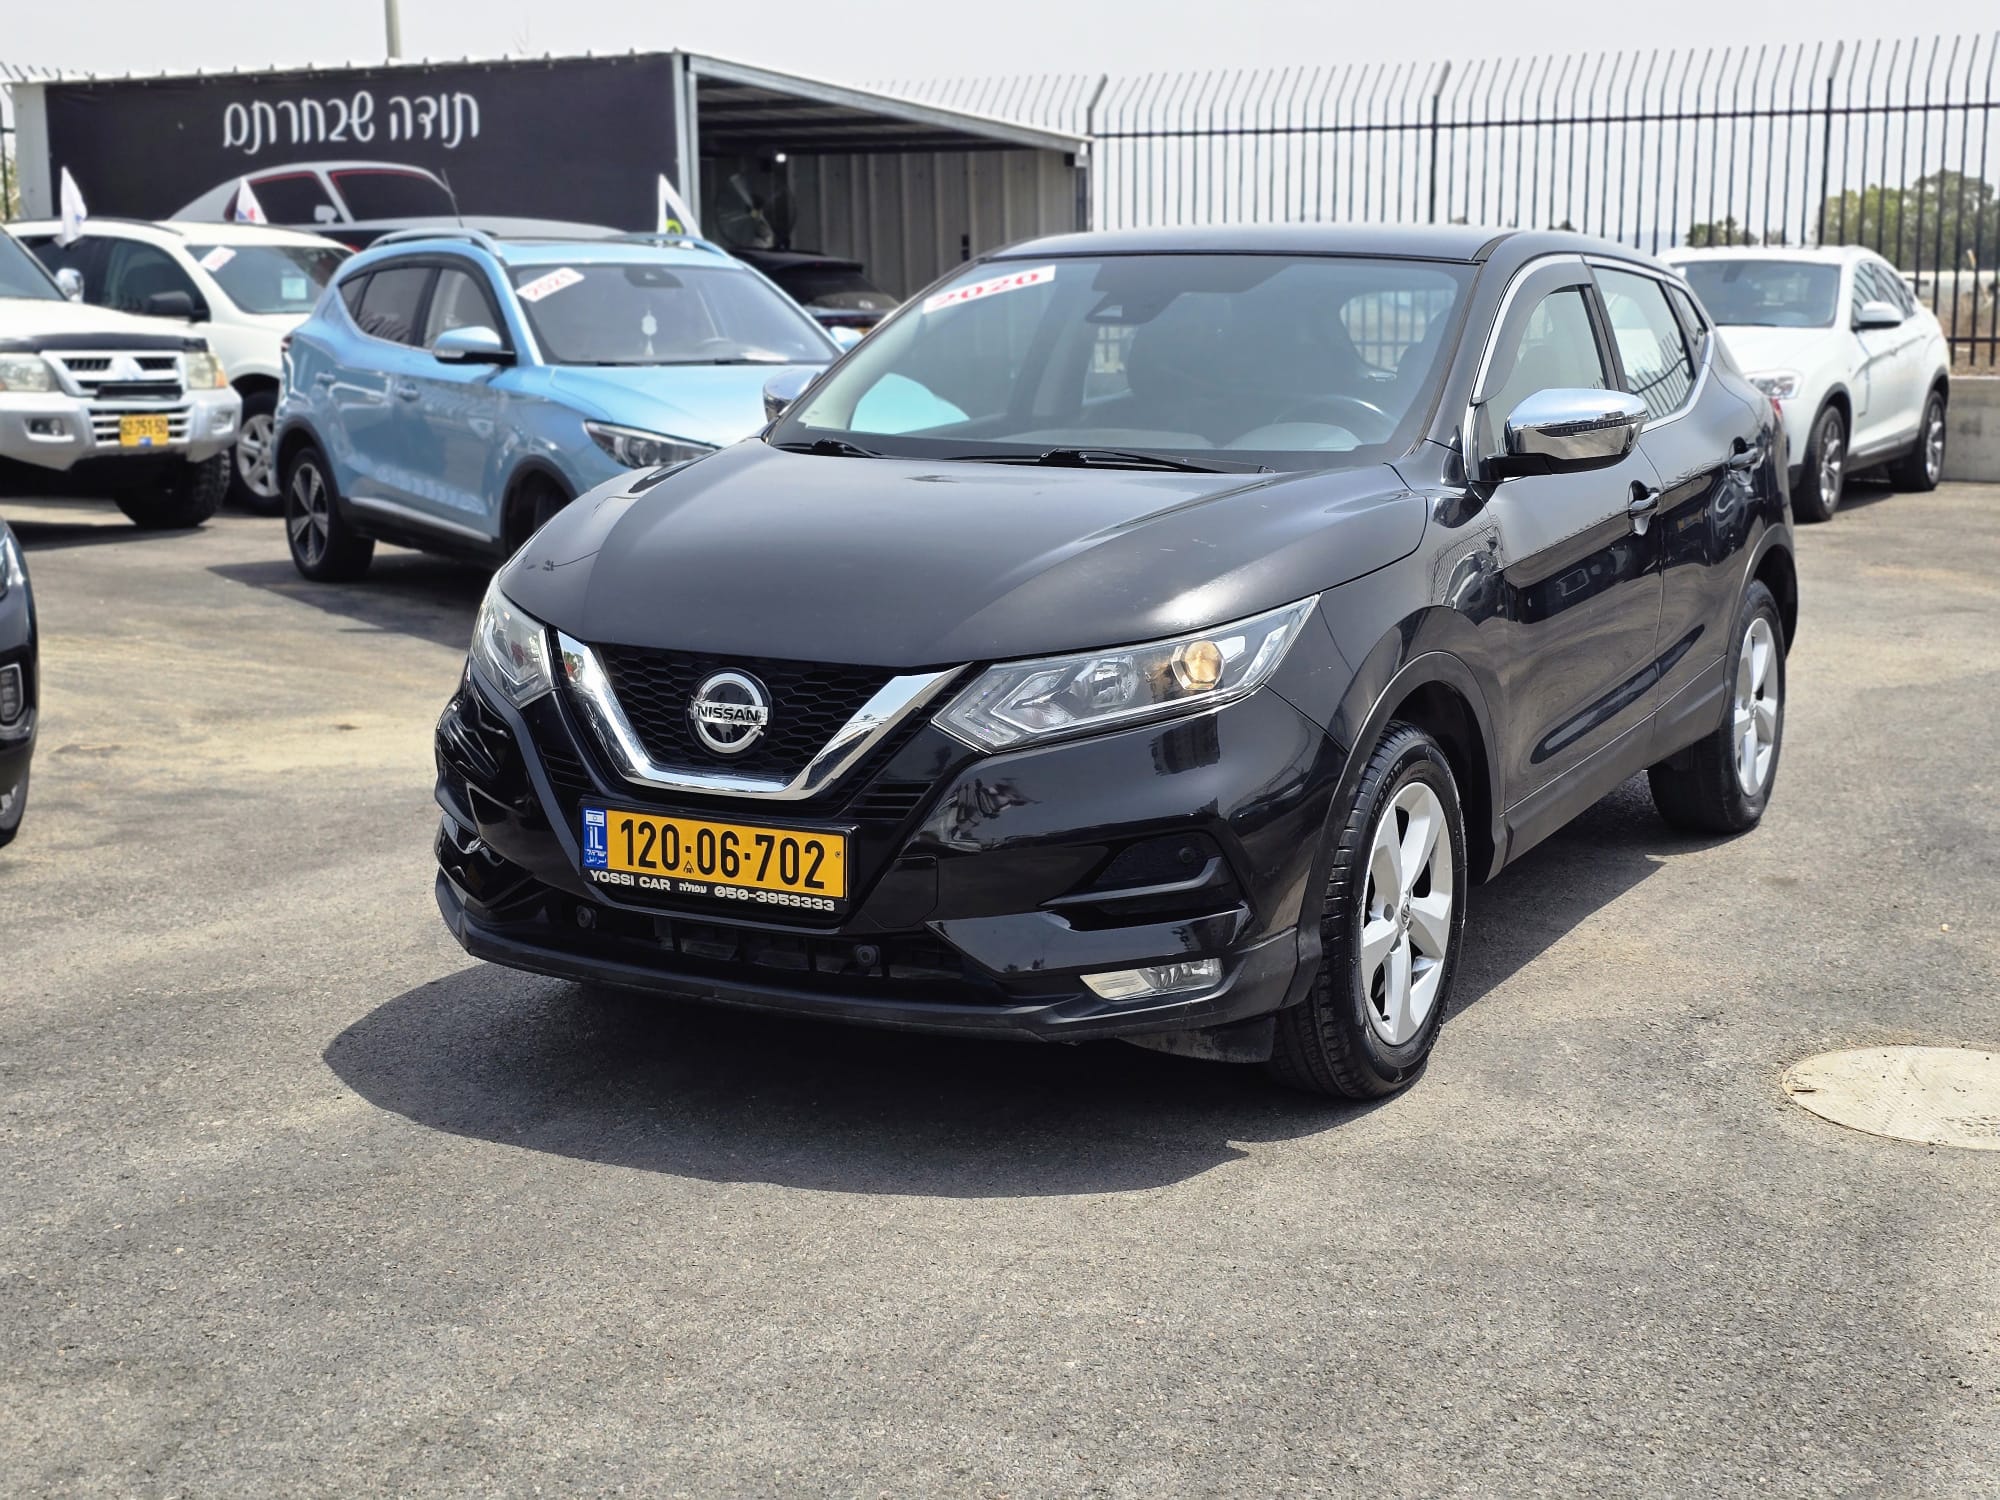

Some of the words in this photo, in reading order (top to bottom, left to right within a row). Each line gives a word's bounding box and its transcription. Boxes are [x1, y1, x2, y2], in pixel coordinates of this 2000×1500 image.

[223, 90, 375, 155] שבחרתם
[389, 92, 479, 149] תודה
[934, 273, 1039, 307] 2020
[697, 705, 760, 722] NISSAN
[589, 869, 635, 886] YOSSI
[639, 876, 671, 891] CAR
[679, 881, 708, 894] עפולה
[714, 885, 836, 912] 050-3953333
